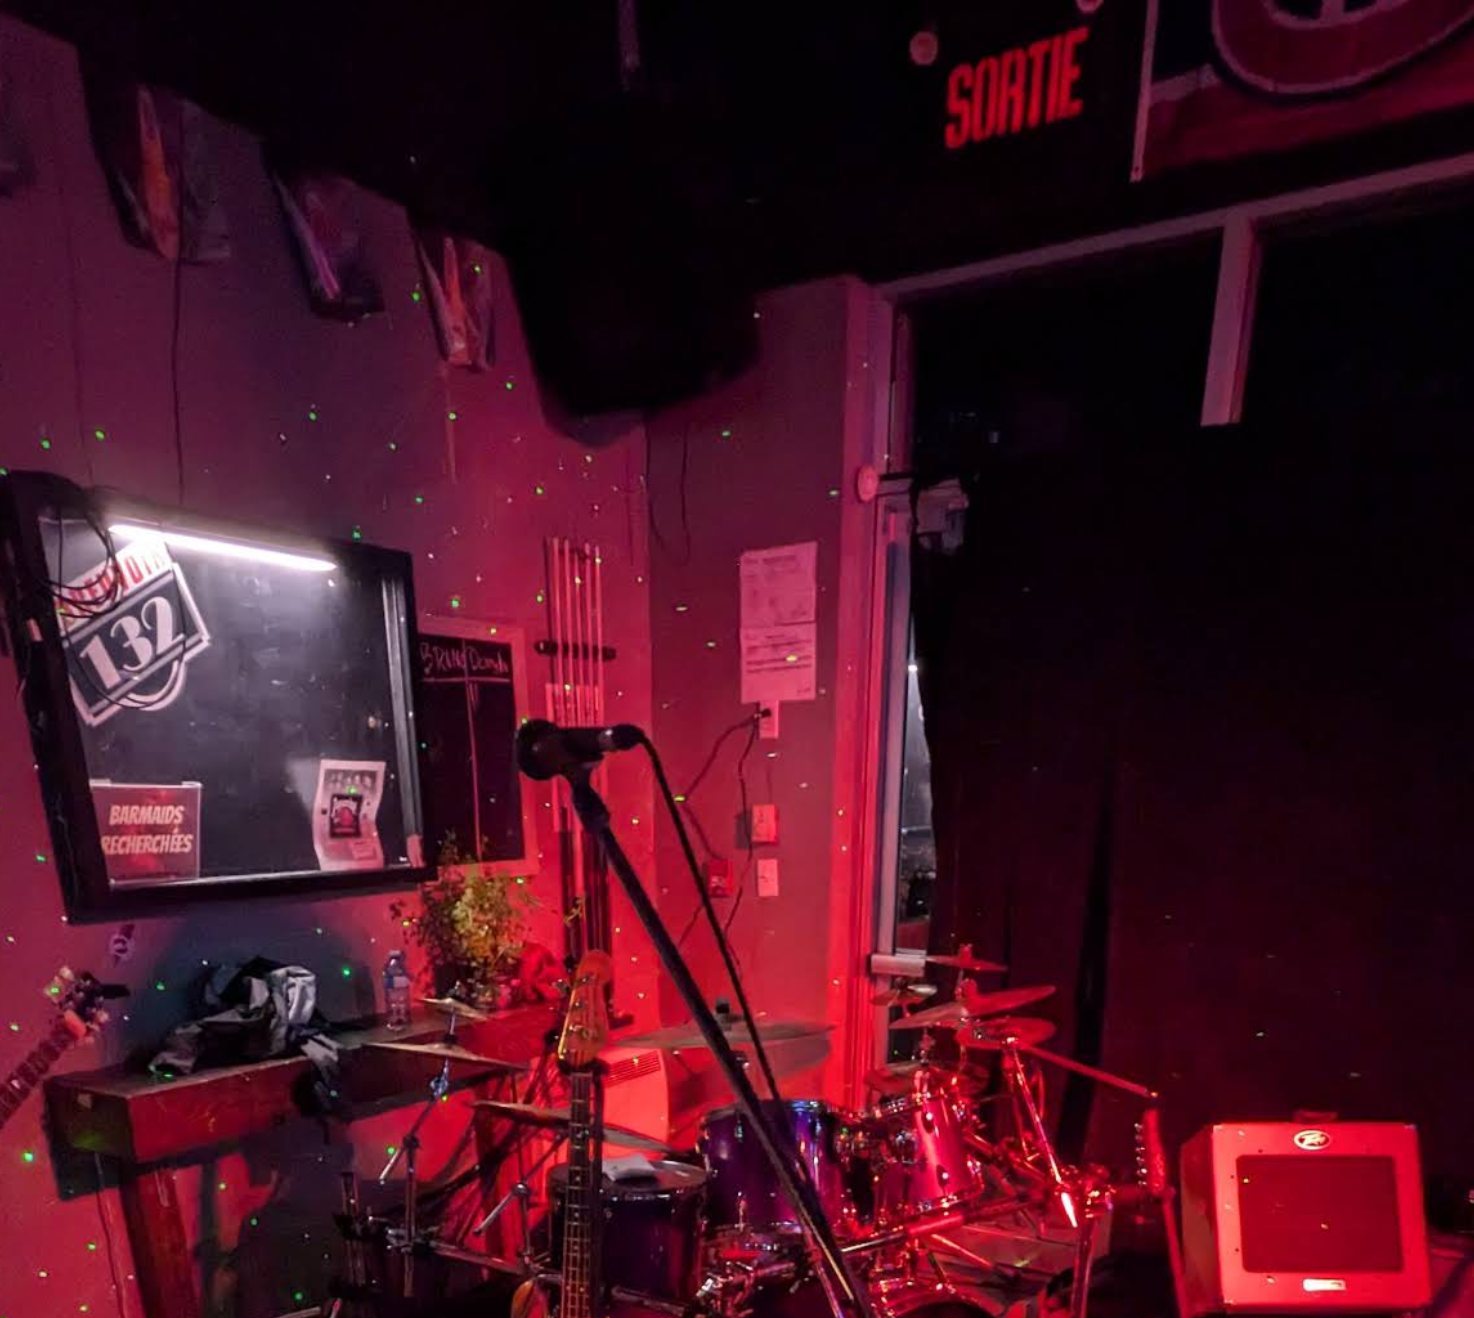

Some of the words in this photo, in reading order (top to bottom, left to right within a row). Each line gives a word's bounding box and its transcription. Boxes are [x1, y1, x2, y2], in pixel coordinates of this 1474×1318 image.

[945, 26, 1089, 149] SORTIE
[79, 596, 185, 690] 132
[101, 827, 194, 855] RECHERCHÉES
[109, 804, 185, 826] BARMAIDS
